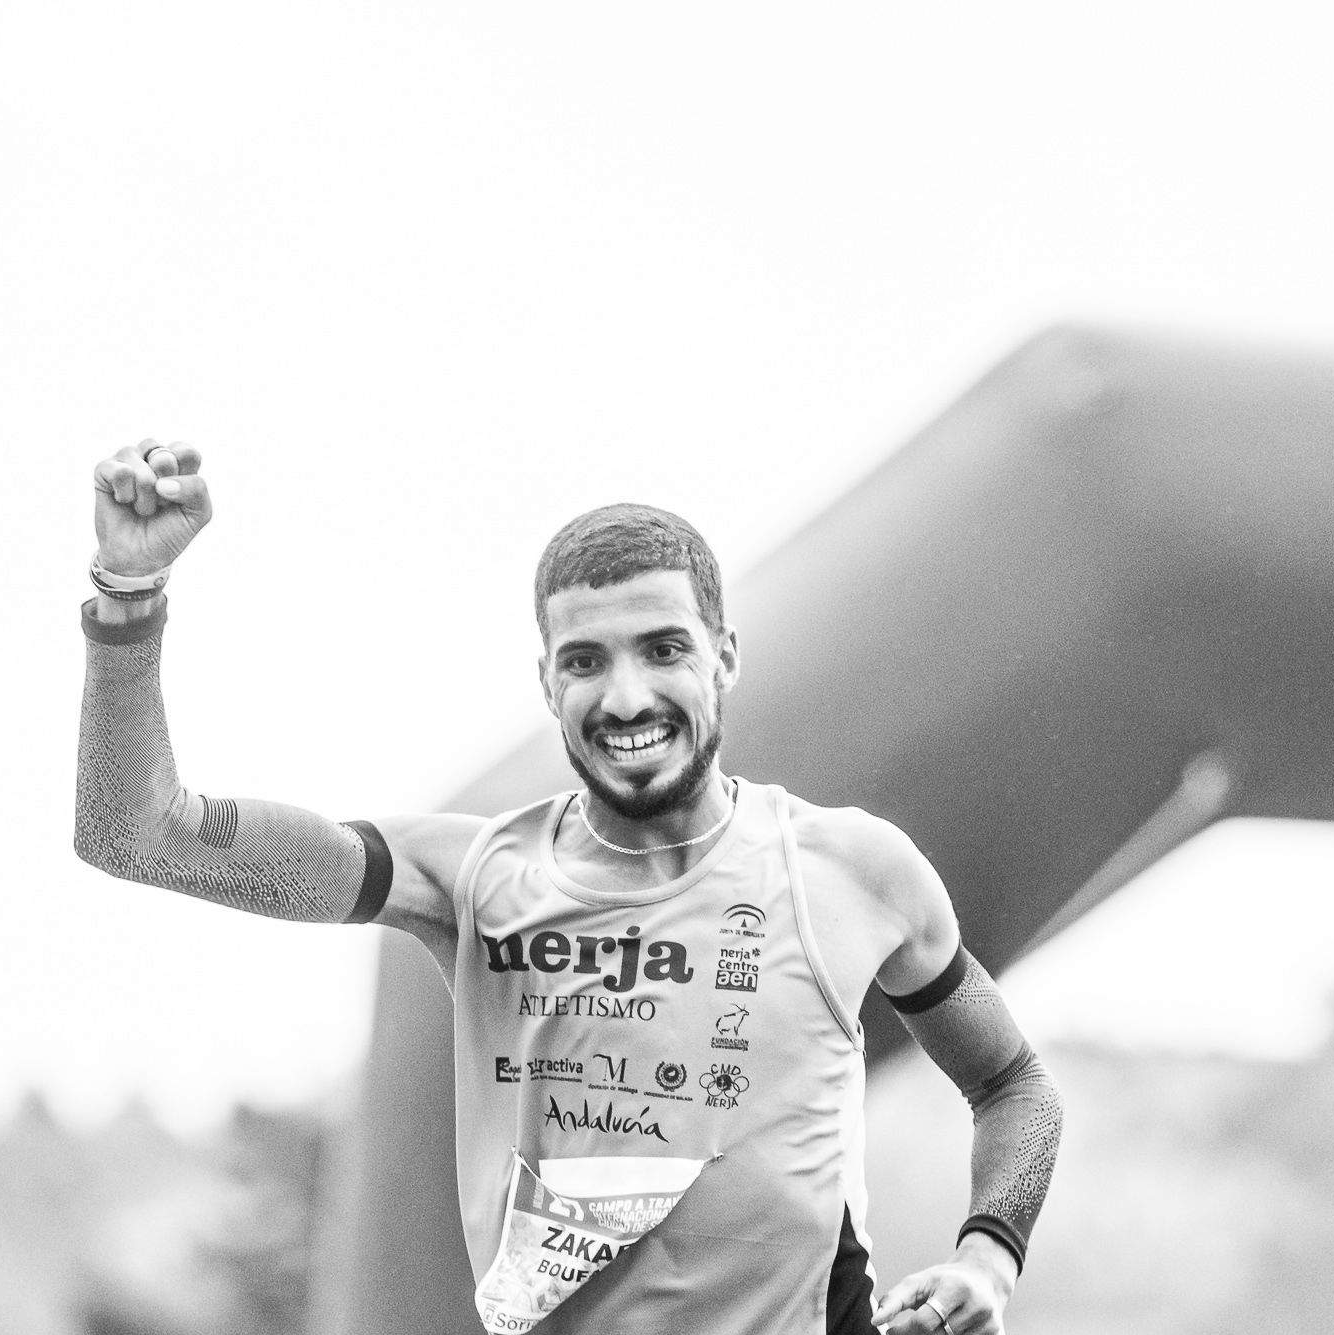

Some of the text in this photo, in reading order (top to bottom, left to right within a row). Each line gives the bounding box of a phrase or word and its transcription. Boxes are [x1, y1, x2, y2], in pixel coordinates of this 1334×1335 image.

[481, 925, 694, 993] nerja
[720, 947, 750, 961] nerja
[718, 959, 759, 972] Centro
[717, 971, 757, 988] aen
[518, 993, 656, 1022] ATLETISMO
[547, 1058, 584, 1074] activa
[710, 1063, 742, 1076] CMD
[705, 1095, 739, 1110] NERJA
[544, 1094, 670, 1144] Andalucía
[588, 1199, 632, 1213] CAMPO
[634, 1198, 644, 1211] A
[537, 1258, 600, 1282] BOUF
